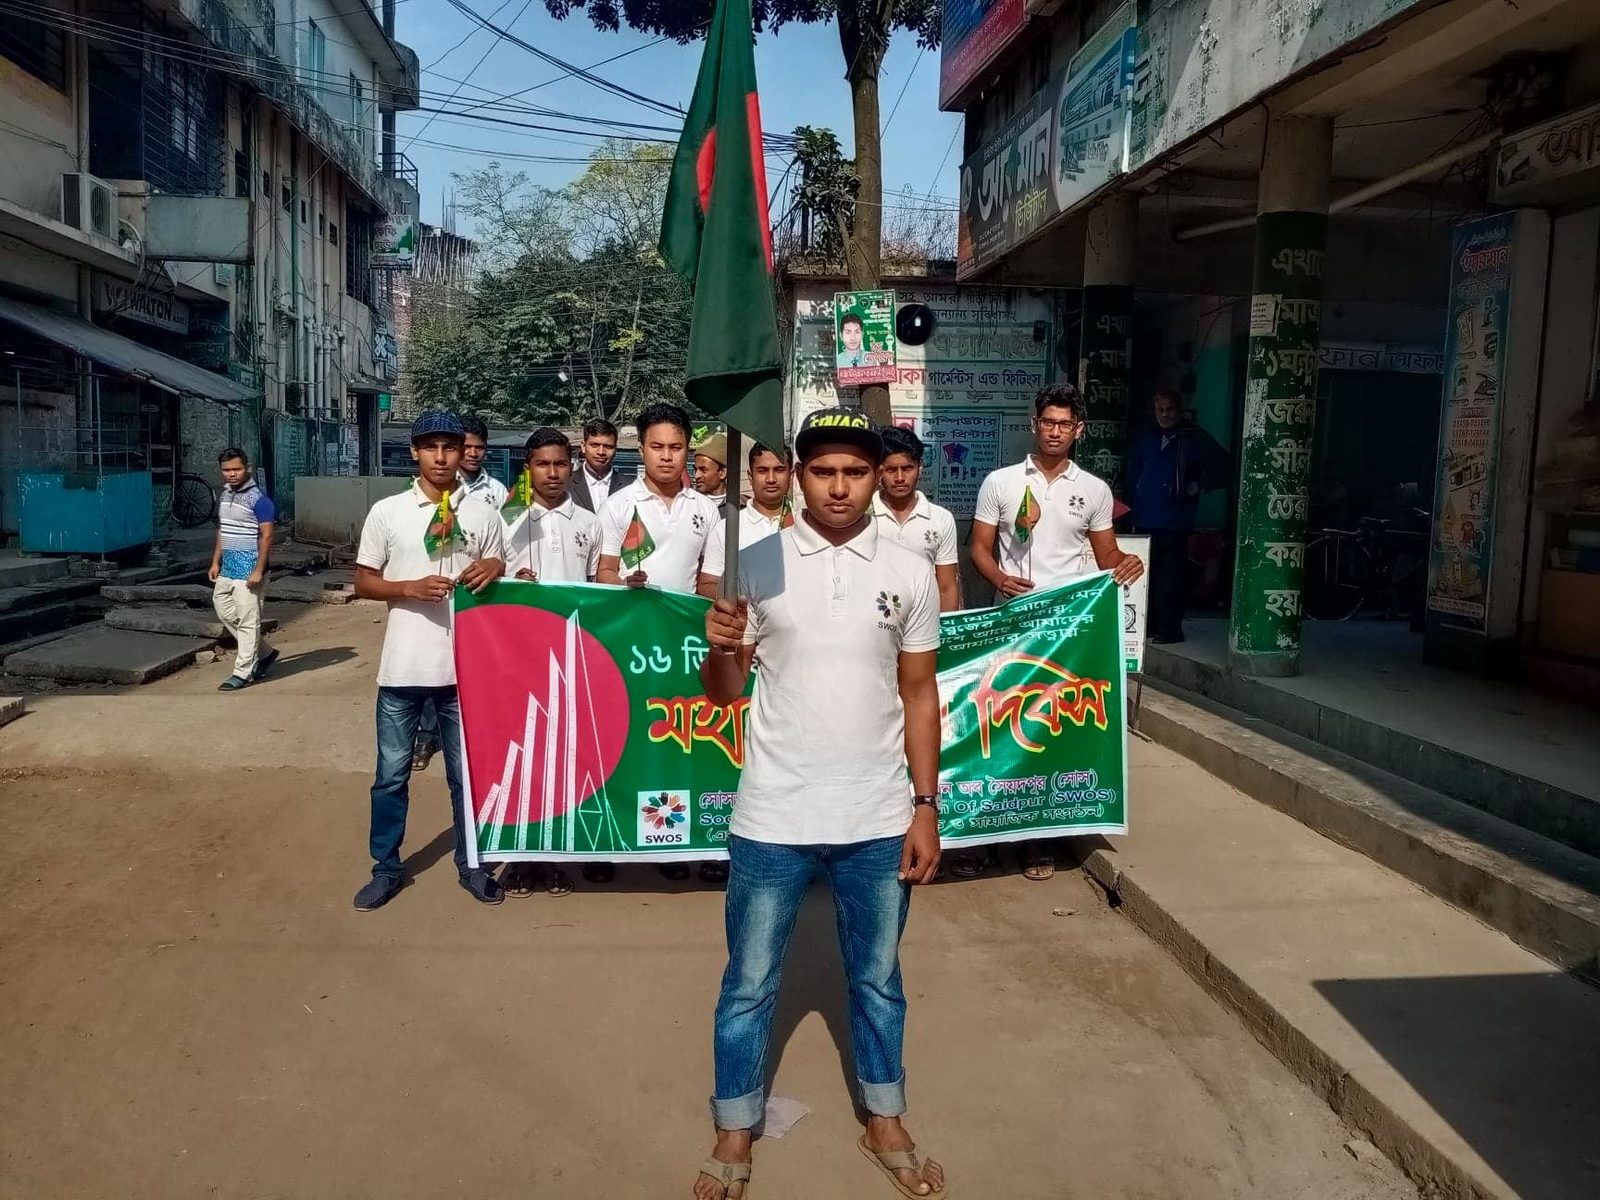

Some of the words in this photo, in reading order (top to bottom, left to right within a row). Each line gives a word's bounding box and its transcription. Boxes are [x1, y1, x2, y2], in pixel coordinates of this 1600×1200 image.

[923, 292, 959, 304] আমরা
[1003, 369, 1041, 386] ফিটিংস
[922, 415, 997, 427] কম্পিউটার
[1263, 542, 1305, 568] করা
[962, 611, 1002, 623] মিশে
[1019, 613, 1096, 629] আমাদের
[877, 621, 898, 632] SWOS
[948, 632, 1021, 652] আমাদের
[630, 644, 672, 674] ১৬
[968, 652, 1111, 760] দিবস
[955, 779, 984, 799] অব
[985, 774, 1047, 797] সৈয়দপুর
[1051, 768, 1098, 793] (সোস)
[954, 799, 977, 813] Of
[980, 796, 1046, 813] Saidpur
[1049, 788, 1117, 807] (SWOS)
[970, 811, 1040, 828] সামাজিক
[645, 833, 682, 844] SWOS
